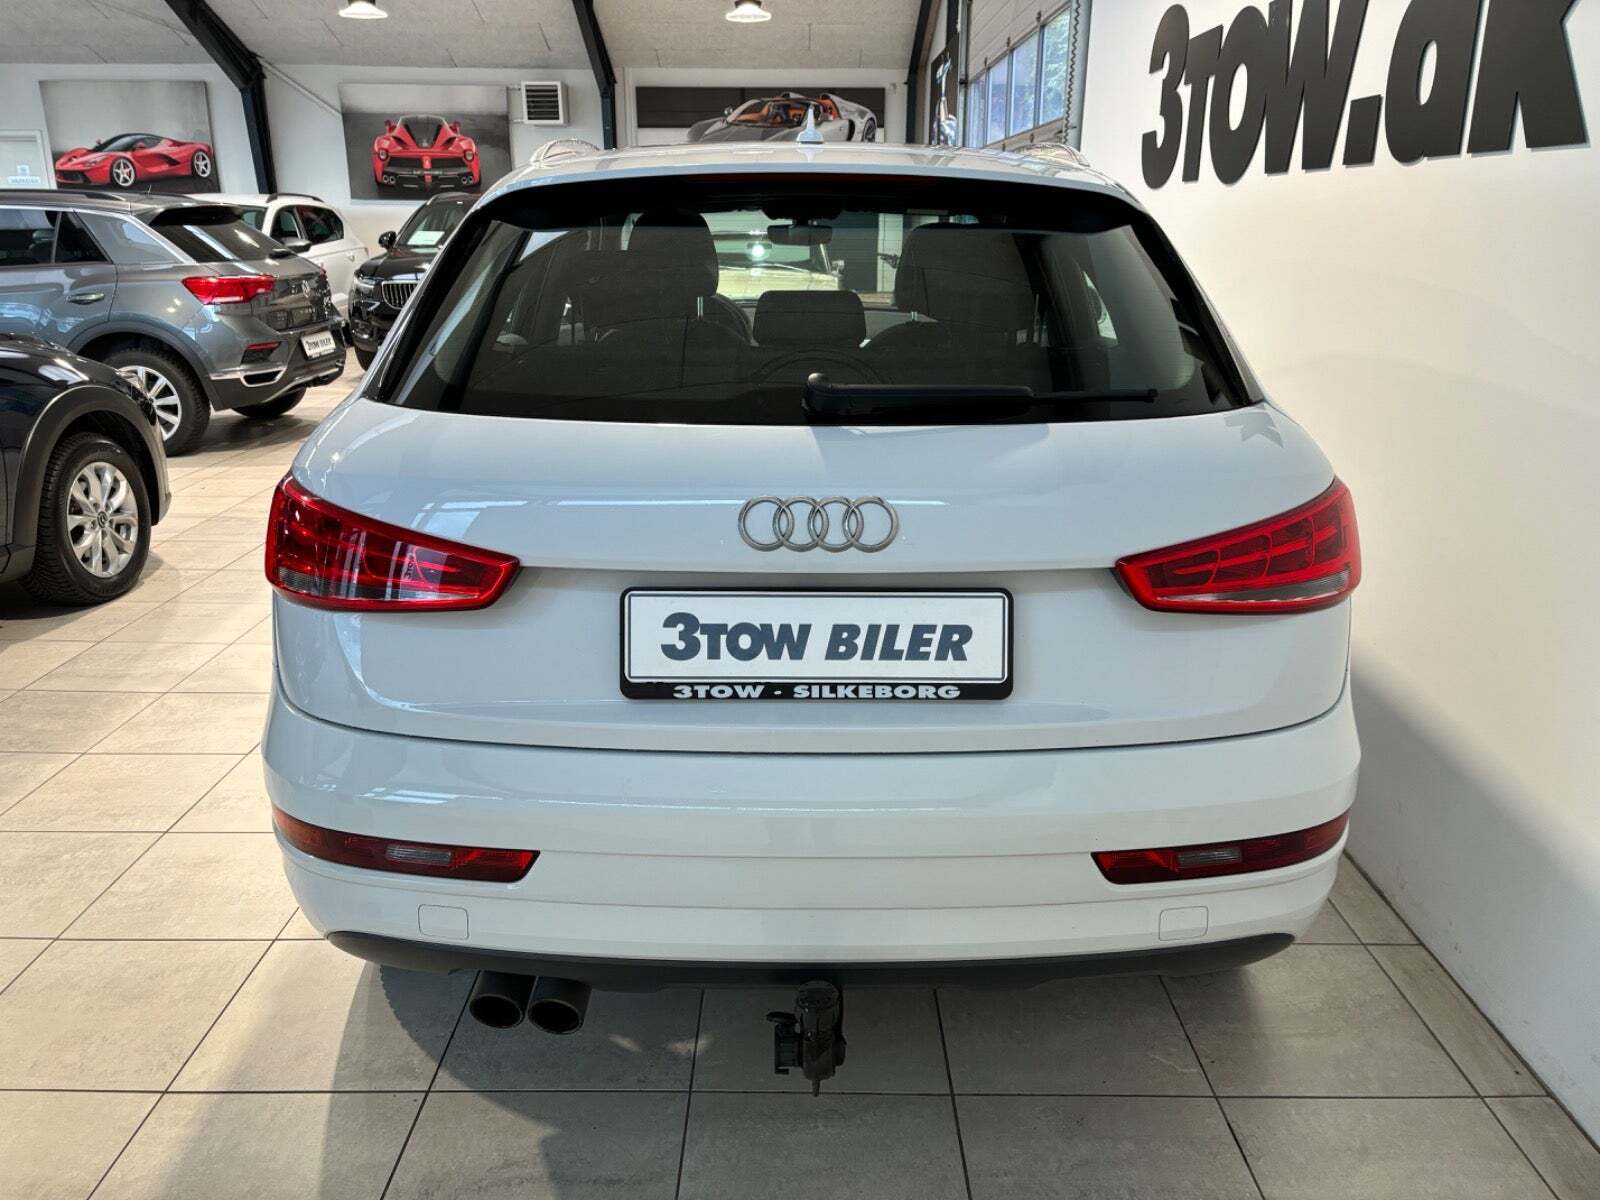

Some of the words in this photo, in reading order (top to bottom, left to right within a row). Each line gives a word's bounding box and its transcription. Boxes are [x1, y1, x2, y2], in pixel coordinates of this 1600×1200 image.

[661, 612, 812, 662] 3TOW
[824, 624, 973, 662] BILER
[673, 684, 765, 699] 3TOW
[793, 684, 961, 699] SILKEBORG
